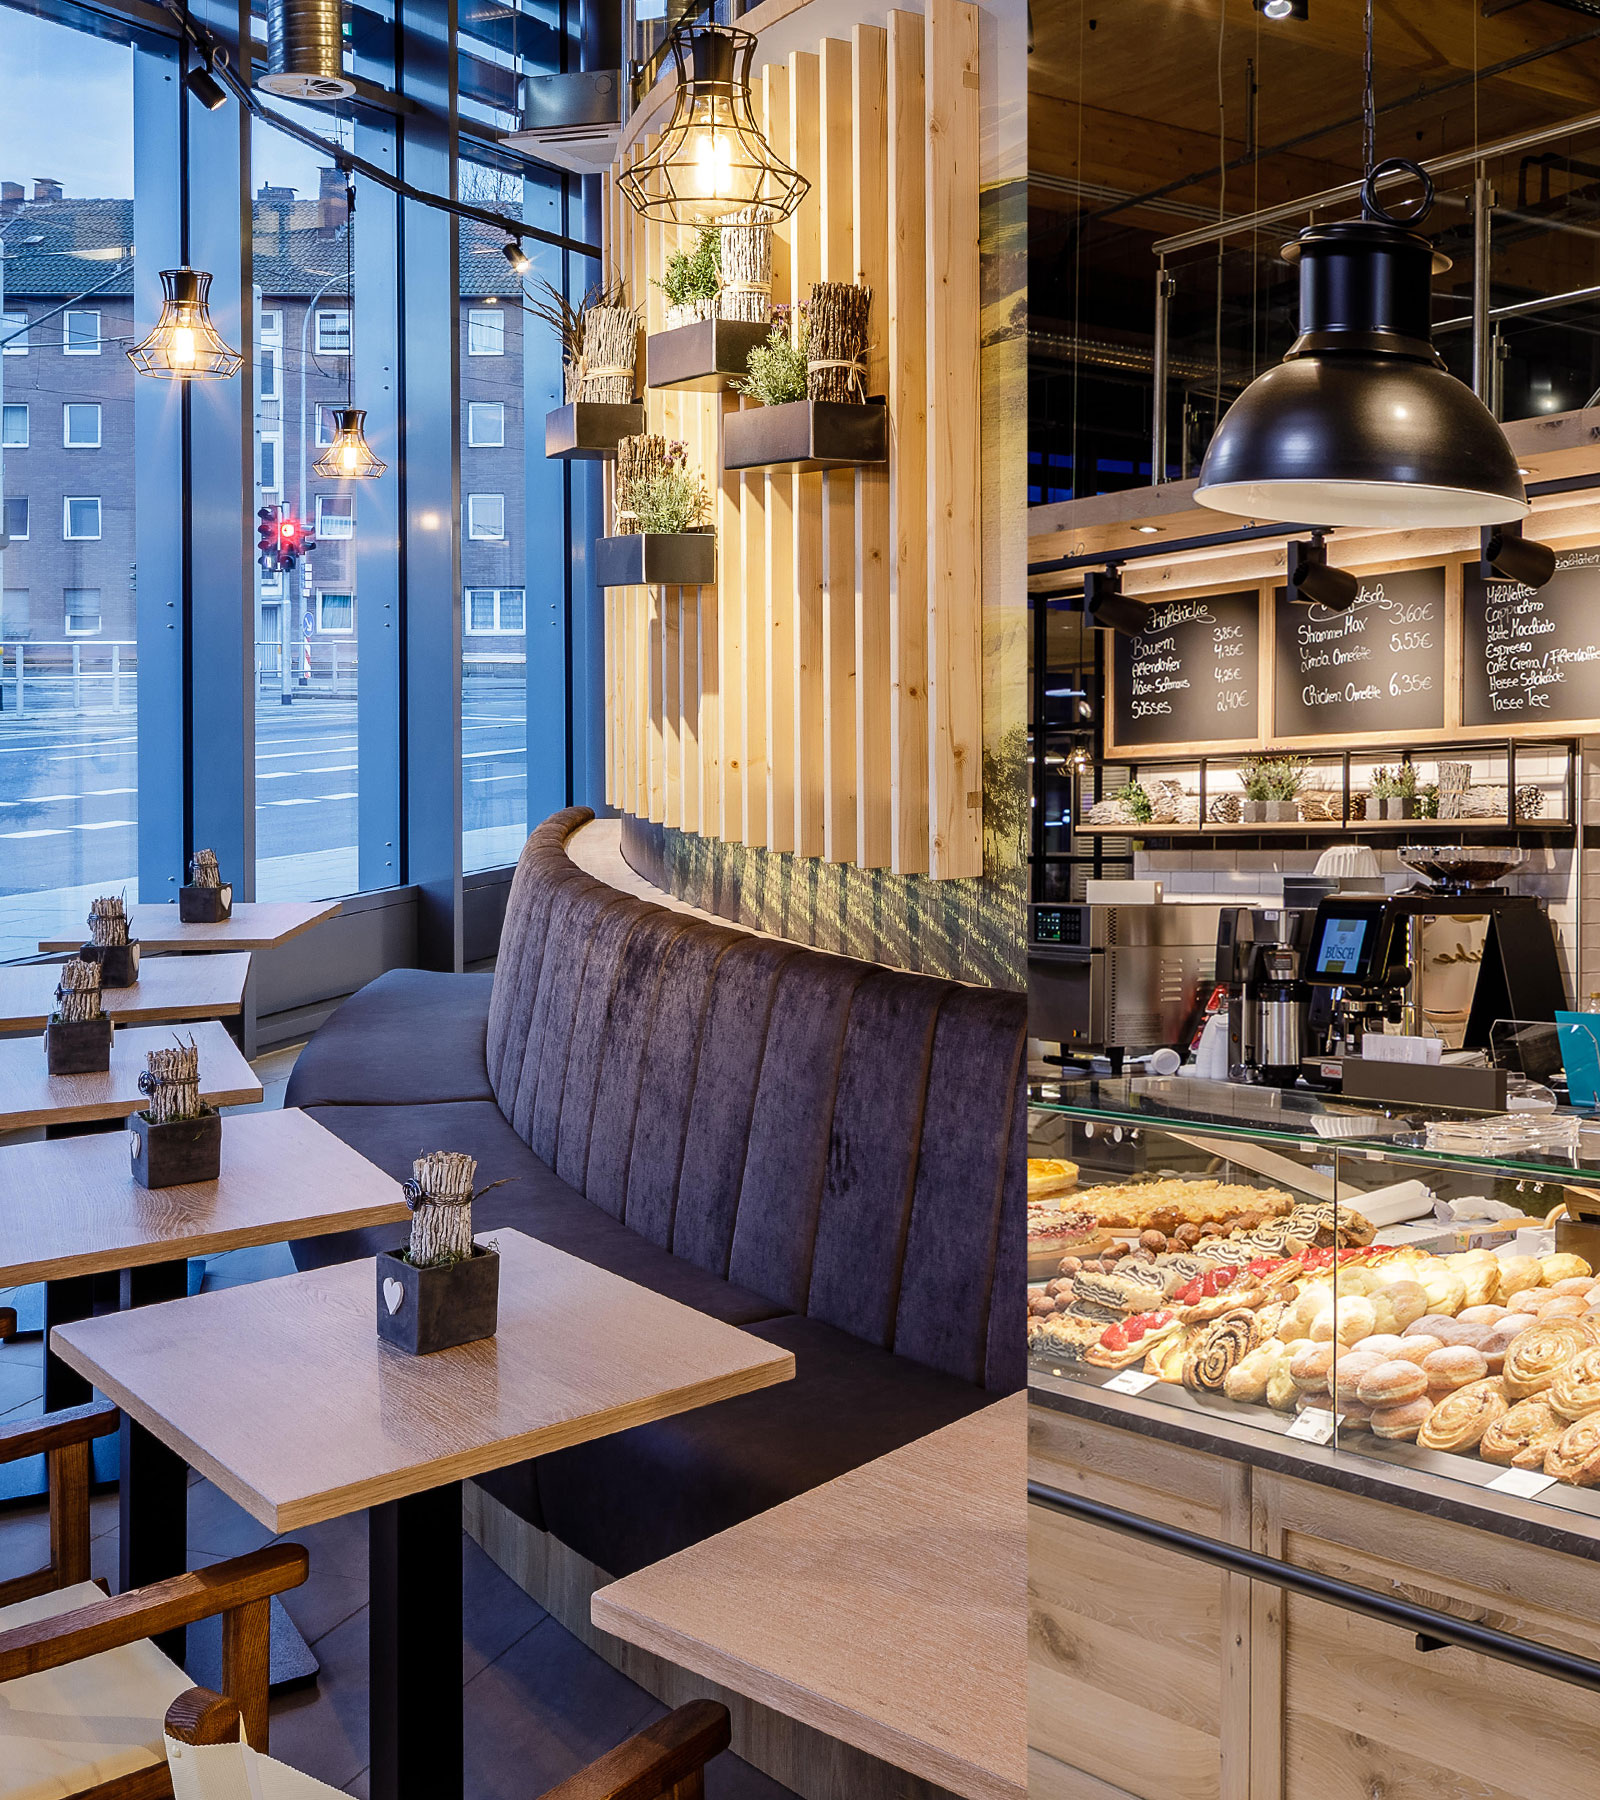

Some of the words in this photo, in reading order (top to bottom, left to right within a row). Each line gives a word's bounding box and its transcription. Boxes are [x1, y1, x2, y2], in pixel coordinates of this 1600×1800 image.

[1344, 615, 1368, 636] Max
[1485, 641, 1532, 658] Espresso
[1302, 684, 1342, 707] Chicken
[1489, 691, 1524, 712] Tasse
[1524, 686, 1551, 708] Tee
[1325, 944, 1356, 960] BÜSCH
